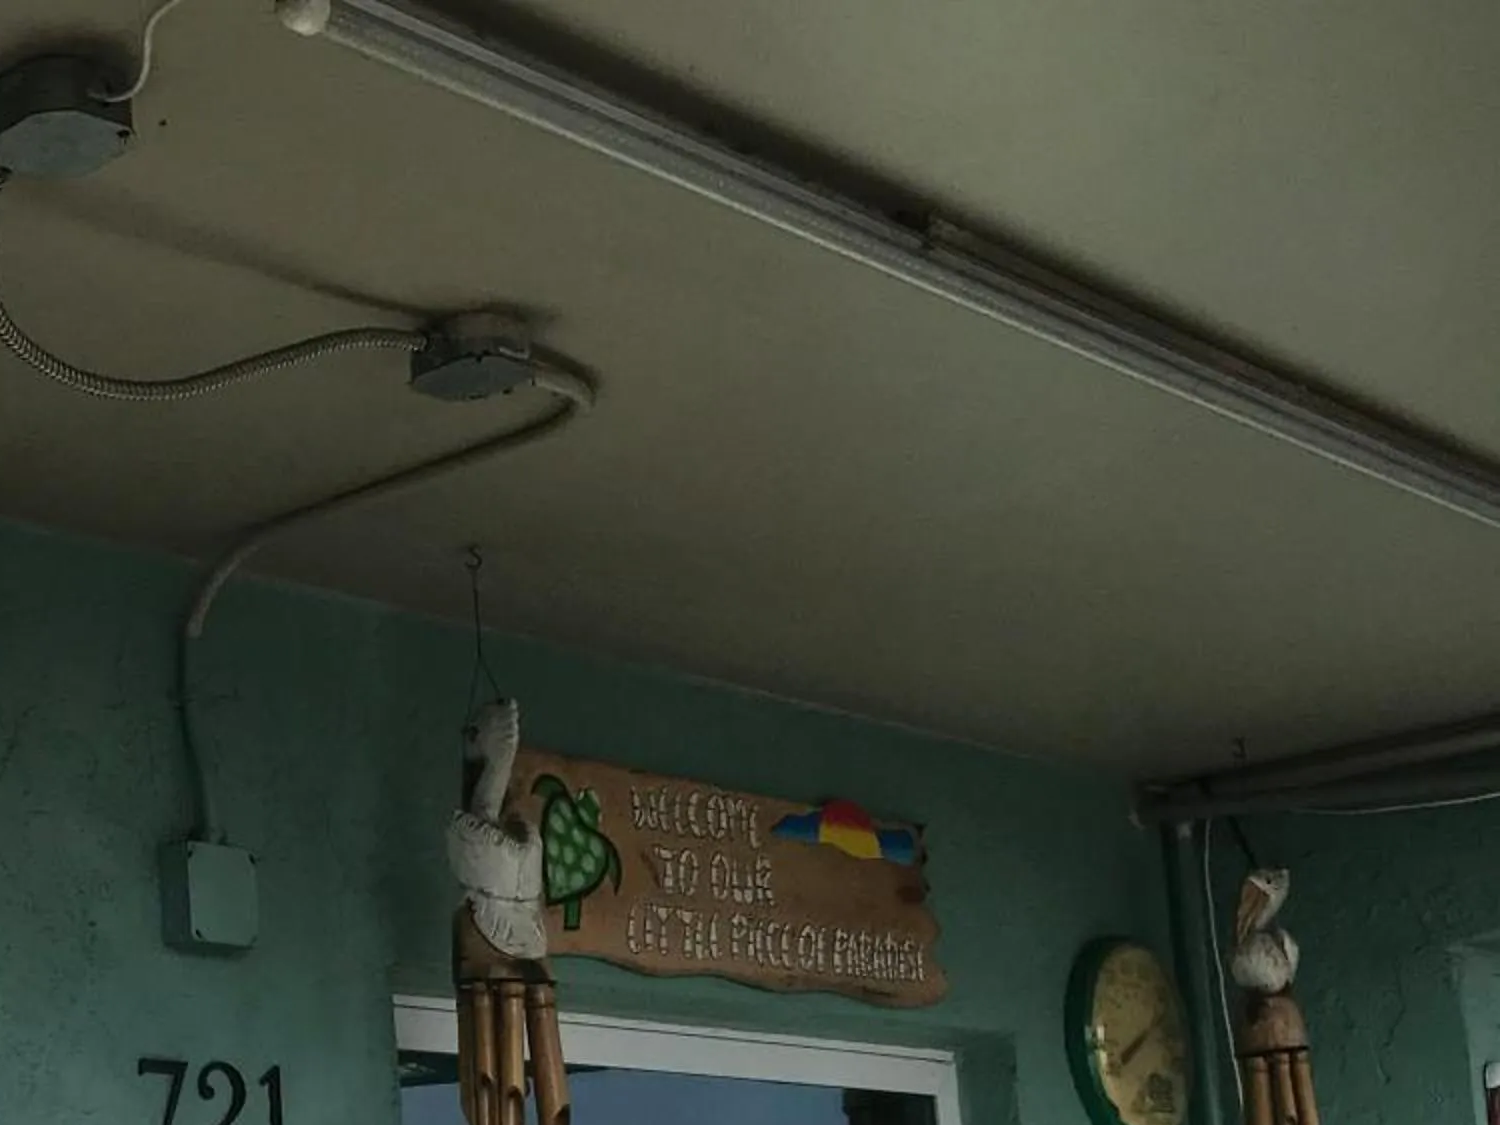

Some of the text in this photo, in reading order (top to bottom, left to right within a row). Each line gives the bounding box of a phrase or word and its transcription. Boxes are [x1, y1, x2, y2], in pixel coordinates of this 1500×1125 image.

[629, 784, 763, 849] WELCOME
[654, 846, 775, 906] TO OUR
[628, 902, 926, 982] LITTLE PIECE OF PARADISE
